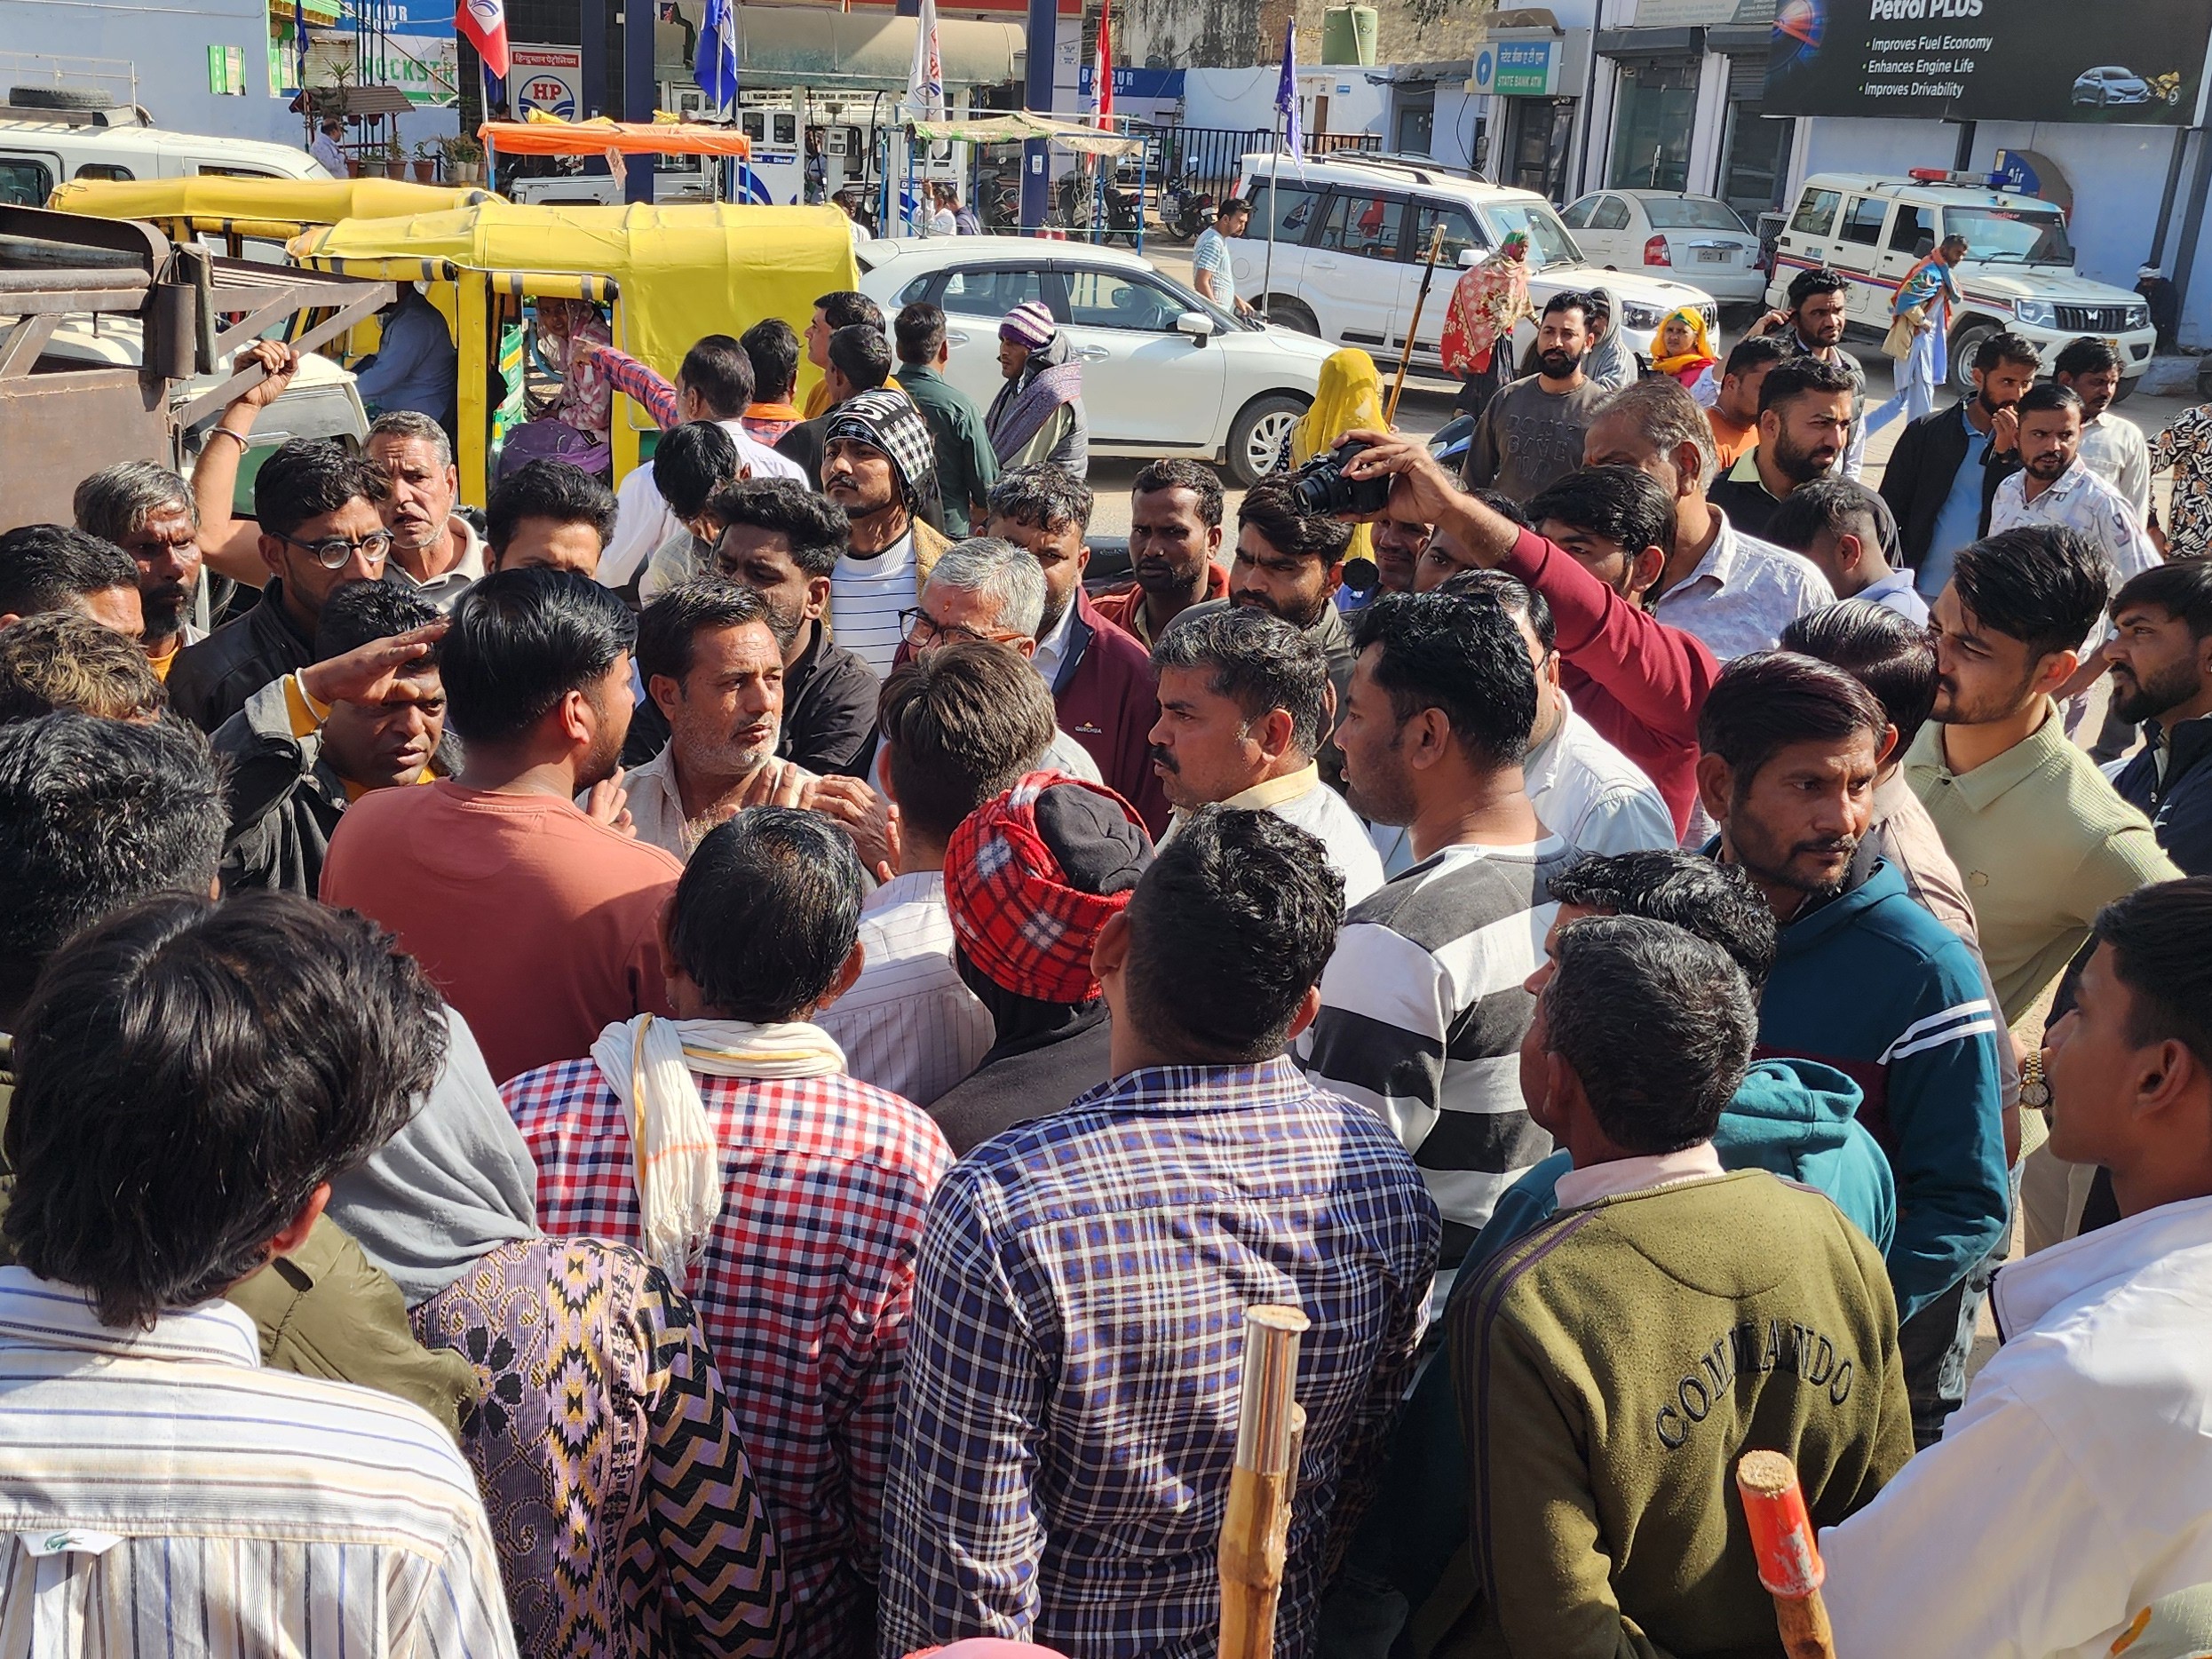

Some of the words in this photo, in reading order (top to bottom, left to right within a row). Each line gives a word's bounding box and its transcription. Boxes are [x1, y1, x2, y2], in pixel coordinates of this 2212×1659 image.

[1869, 0, 1926, 20] Petrol
[1928, 0, 1984, 18] PLUS
[1871, 37, 1916, 53] Improves
[1918, 36, 1942, 51] Fuel
[1942, 36, 1994, 52] Economy
[1867, 60, 1914, 73] Enhances
[1915, 59, 1952, 75] Engine
[1954, 58, 1974, 73] Life
[1497, 75, 1514, 86] STATE
[1514, 75, 1530, 87] BANK
[1530, 76, 1542, 87] ATM
[533, 83, 562, 100] HP
[1864, 82, 1909, 97] Improves
[1910, 82, 1964, 99] Drivability
[2008, 167, 2025, 183] Air
[1656, 1319, 1854, 1450] COMMANDO
